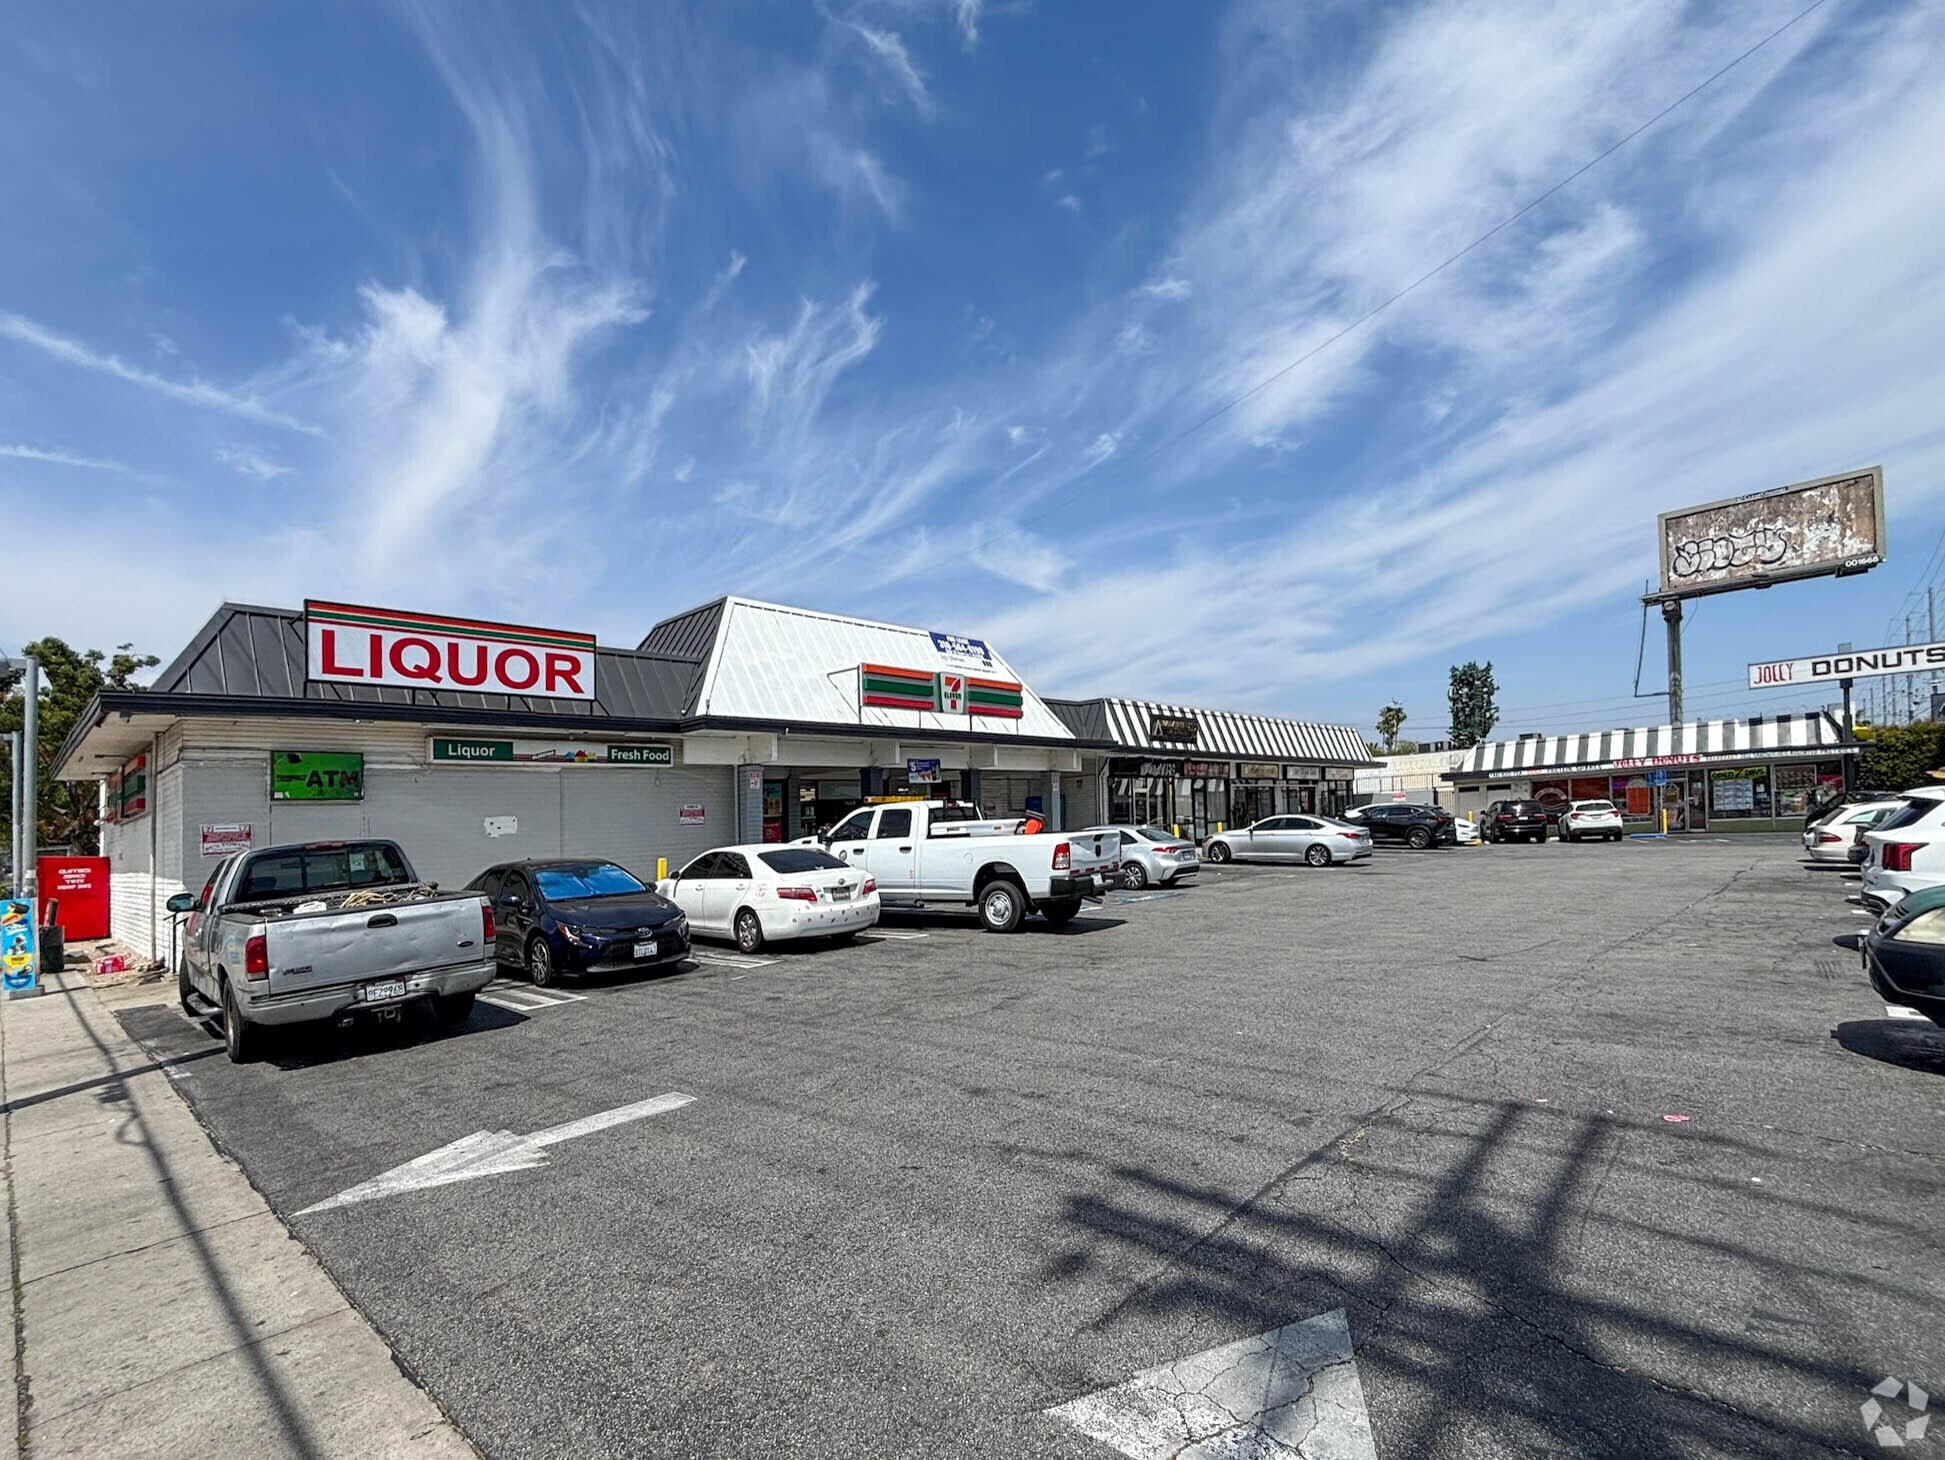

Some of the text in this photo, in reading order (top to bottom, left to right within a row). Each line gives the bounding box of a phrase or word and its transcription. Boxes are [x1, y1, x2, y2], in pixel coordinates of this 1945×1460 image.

[321, 629, 584, 693] LIQUOR
[1753, 647, 1945, 684] JOLLY DONUTS
[945, 676, 961, 693] 7
[448, 743, 669, 761] Liquor Fresh Food
[1612, 754, 1701, 769] JOLLY DONUTS
[305, 770, 359, 788] ATM
